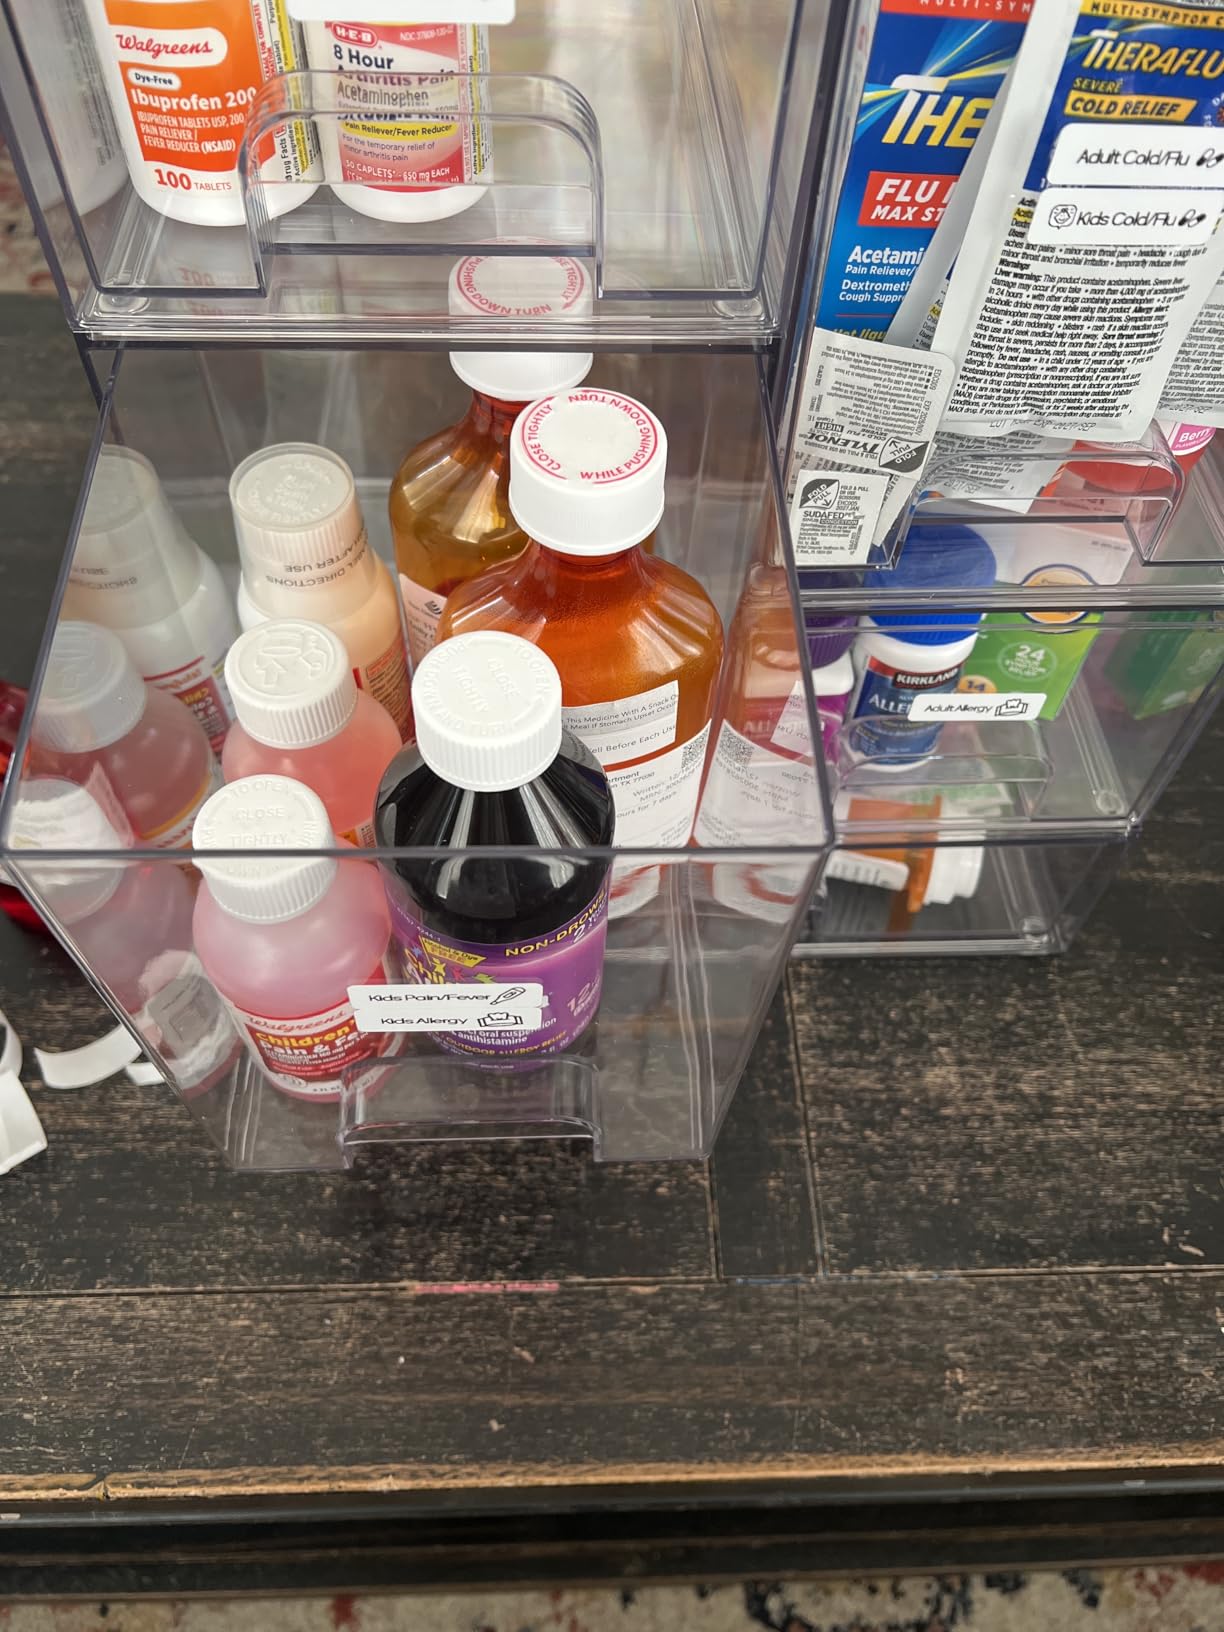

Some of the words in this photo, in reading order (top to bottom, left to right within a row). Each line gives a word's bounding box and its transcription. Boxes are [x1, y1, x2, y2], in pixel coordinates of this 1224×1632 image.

[1091, 1, 1210, 25] MULTI-SYMPTOM
[116, 34, 213, 59] Walgreens
[1081, 29, 1224, 79] THERAFLU
[333, 44, 343, 60] 8
[348, 48, 394, 70] Hour
[135, 72, 173, 86] Dye-Free
[1073, 76, 1124, 93] SEVERE
[131, 88, 222, 112] Ibuprofen
[337, 80, 429, 106] Acetaminophen
[1071, 97, 1119, 115] COLD
[1120, 100, 1181, 117] RELIEF
[137, 111, 178, 127] IBUPROFEN
[178, 115, 210, 128] TABLETS
[212, 116, 229, 128] USP,
[230, 113, 244, 126] 200
[140, 123, 158, 136] PAIN
[159, 127, 192, 140] RELIEVER
[362, 124, 419, 136] Reliever/Fever
[422, 124, 452, 135] Reducer
[144, 135, 166, 149] FEVER
[166, 140, 201, 153] REDUCER
[201, 139, 236, 154] (NSAID)
[280, 138, 288, 158] Facts
[342, 134, 353, 142] For
[354, 136, 366, 146] the
[367, 140, 405, 152] temporary
[407, 141, 426, 151] relief
[427, 141, 436, 149] of
[344, 144, 361, 154] minor
[363, 147, 392, 160] arthritis
[392, 153, 409, 161] pain
[1076, 148, 1122, 165] Adult
[1122, 149, 1191, 166] Cold/Flu
[155, 169, 192, 190] 100
[194, 182, 232, 191] TABLETS
[402, 171, 417, 181] 650
[419, 171, 430, 181] mg
[431, 167, 450, 178] EACH
[876, 178, 939, 203] FLU
[870, 204, 918, 221] MAX
[1076, 211, 1110, 226] Kids
[1112, 211, 1177, 226] Cold/Flu
[463, 257, 483, 293] PUSHING
[845, 265, 867, 274] Pain
[561, 267, 577, 300] TIGHTLY
[472, 293, 511, 314] DOWN
[839, 292, 871, 302] Cough
[514, 303, 552, 315] TURN
[568, 394, 607, 403] TURN
[609, 398, 646, 427] DOWN
[528, 404, 553, 441] TIGHTLY
[816, 423, 842, 431] NIGHT
[624, 427, 652, 470] PUSHING
[807, 432, 880, 455] TYLENOL
[890, 444, 911, 457] PULL
[530, 443, 561, 471] CLOSE
[895, 450, 917, 464] FOLD
[580, 466, 626, 480] WHILE
[808, 484, 827, 499] FOLD
[813, 490, 831, 504] PULL
[803, 510, 845, 519] SUDAFED
[265, 567, 346, 587] DIRECTIONS
[283, 564, 313, 573] USE
[1015, 645, 1046, 661] 24
[896, 667, 958, 686] KIRKLAND
[567, 716, 582, 724] This
[583, 713, 620, 723] Medicine
[621, 709, 640, 717] With
[648, 698, 669, 710] Snack
[924, 703, 955, 713] Adult
[955, 703, 993, 715] Allergy
[599, 717, 633, 728] Stomach
[634, 709, 655, 720] Upset
[606, 739, 636, 751] Before
[639, 732, 660, 743] Each
[573, 924, 586, 943] 2
[369, 994, 402, 1002] Kids
[405, 994, 491, 1002] Pain/Fever
[249, 1010, 347, 1032] Walgreens
[381, 1017, 414, 1025] Kids
[416, 1017, 468, 1026] Allergy
[259, 1040, 307, 1056] Pain
[313, 1044, 330, 1054] &
[458, 1033, 527, 1046] antihistamine
